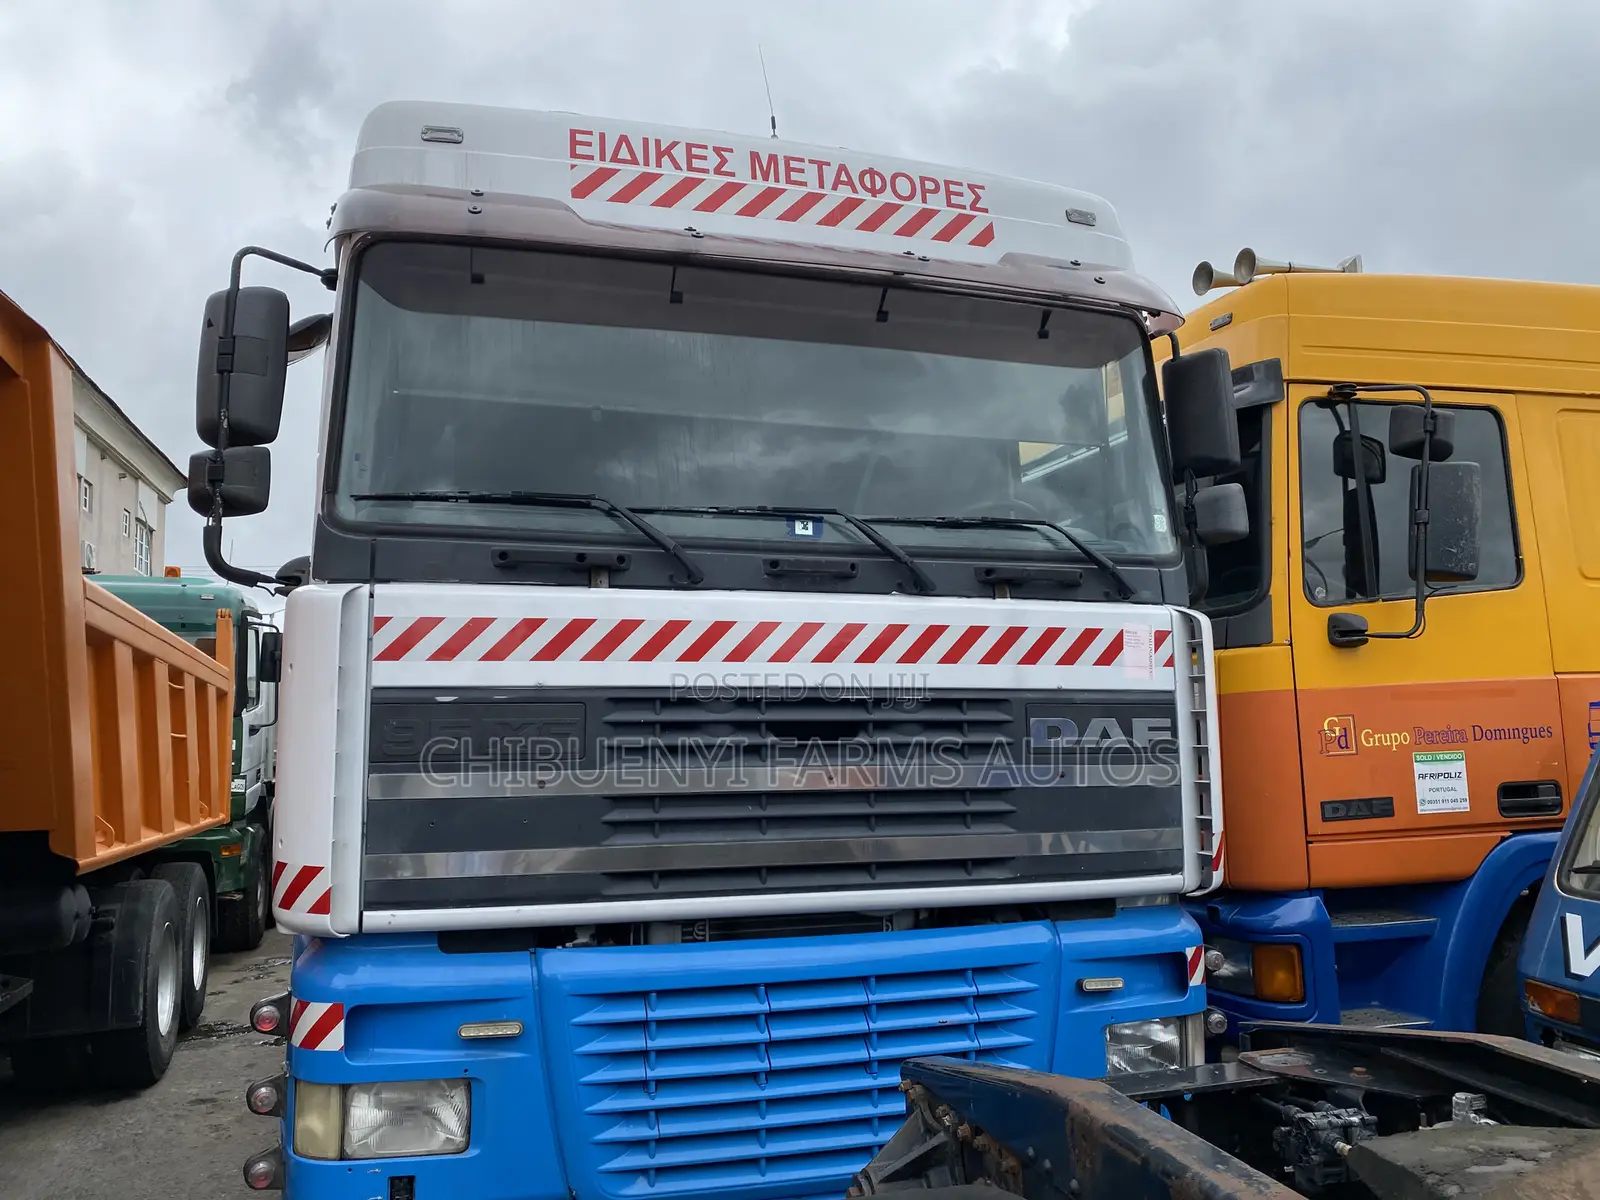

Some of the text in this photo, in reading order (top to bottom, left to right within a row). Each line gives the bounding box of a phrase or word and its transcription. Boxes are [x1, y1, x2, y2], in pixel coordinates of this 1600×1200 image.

[568, 128, 989, 214] ΕΙΔΙΚΕΣ ΜΕΤΑΦΟΡΕΣ
[1029, 717, 1172, 748] DAF
[1360, 724, 1553, 751] Grupo Pereira Domingues
[1323, 800, 1394, 818] DAF
